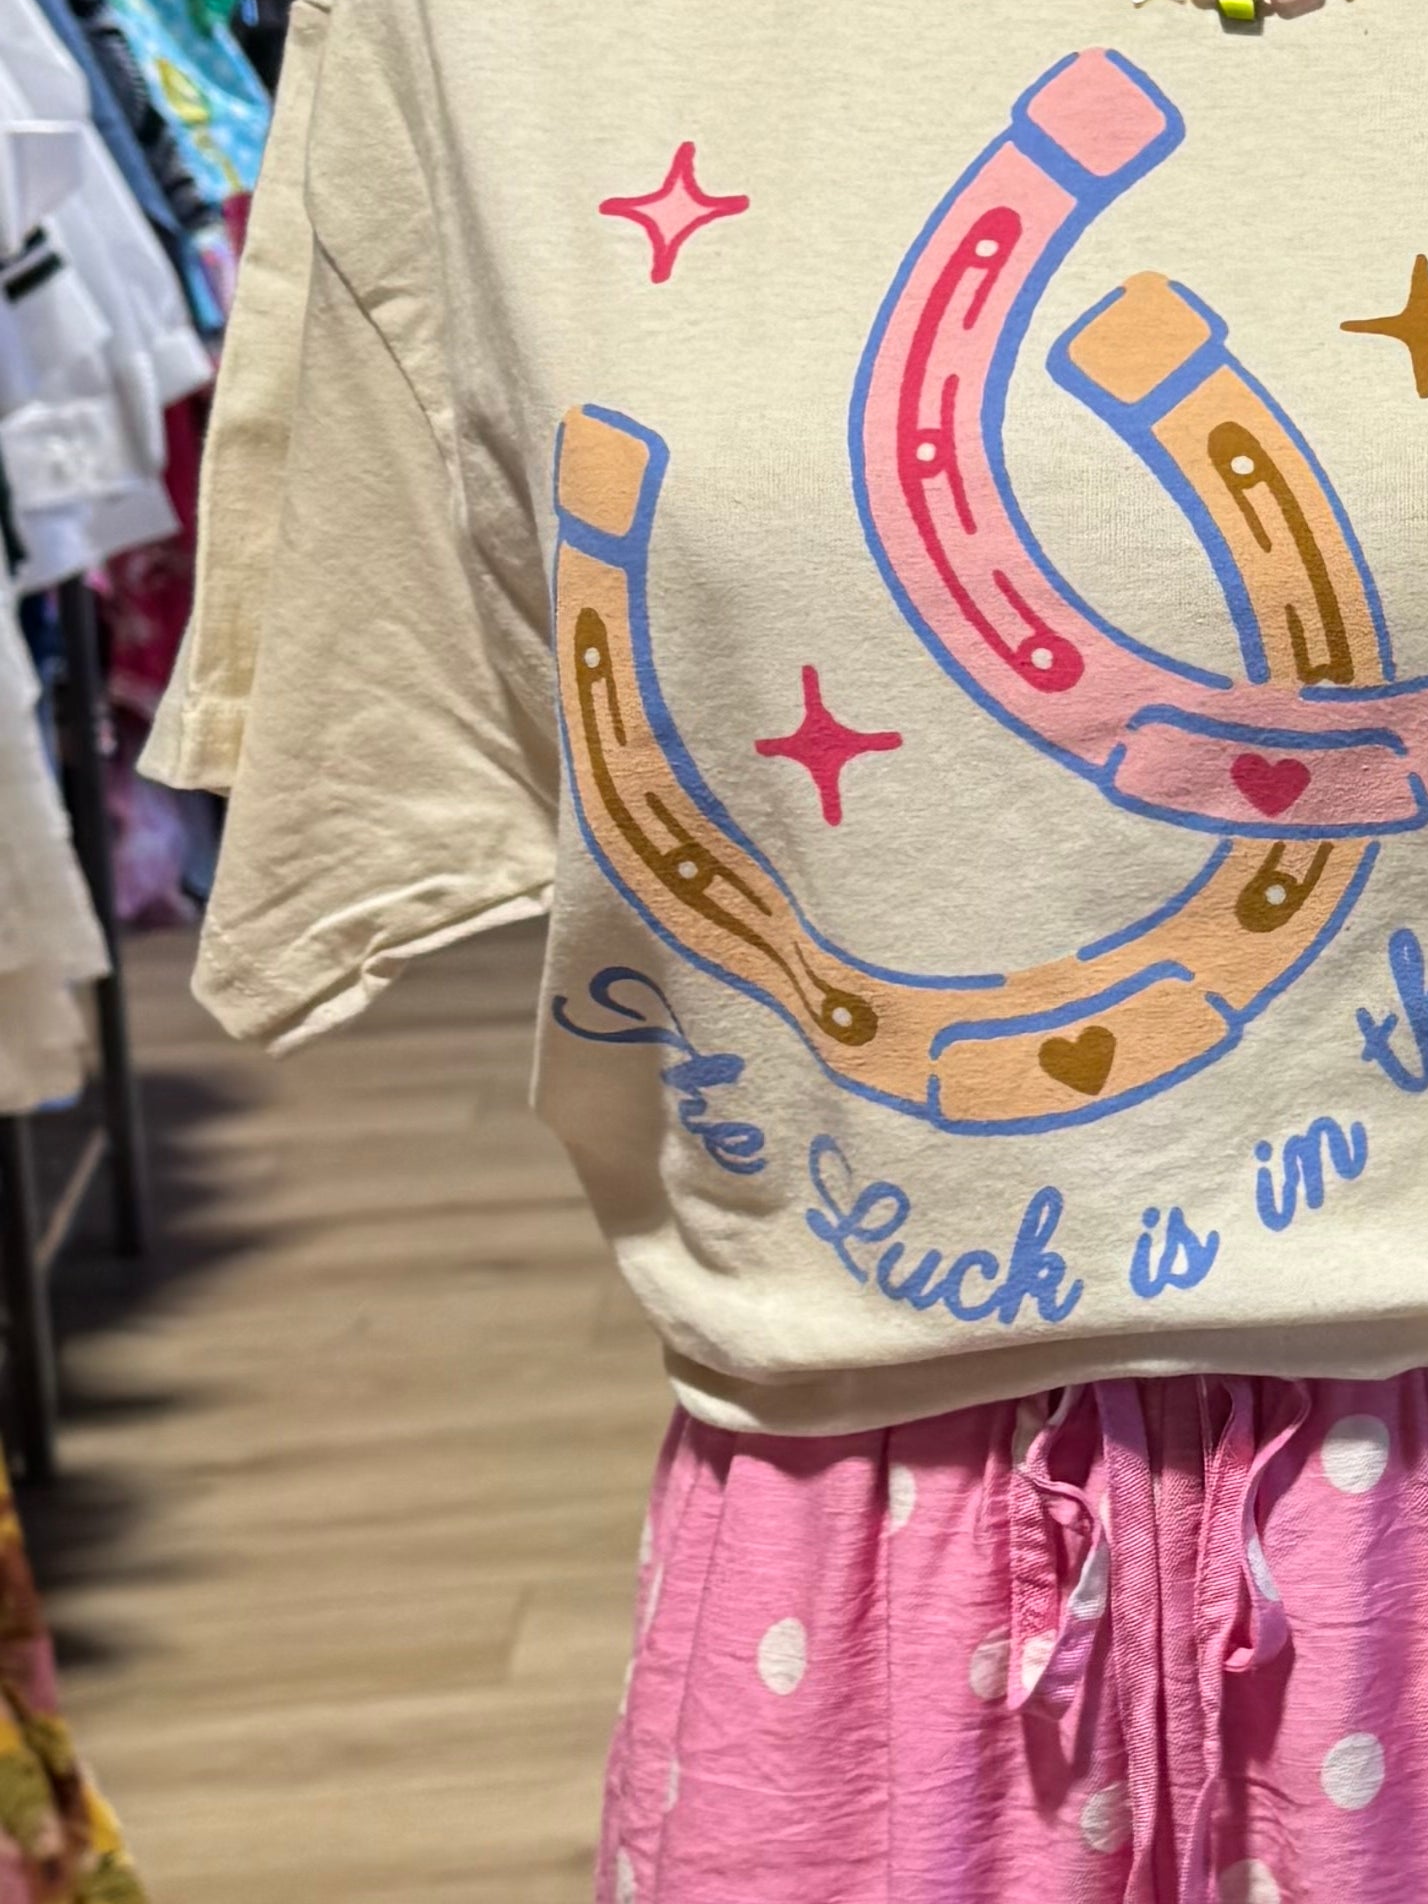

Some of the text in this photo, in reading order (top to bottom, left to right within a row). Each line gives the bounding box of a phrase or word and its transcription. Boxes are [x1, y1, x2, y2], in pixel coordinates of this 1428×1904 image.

[552, 966, 767, 1174] The
[805, 1134, 1083, 1326] Luck
[1129, 1206, 1221, 1299] is
[1254, 1116, 1368, 1231] in
